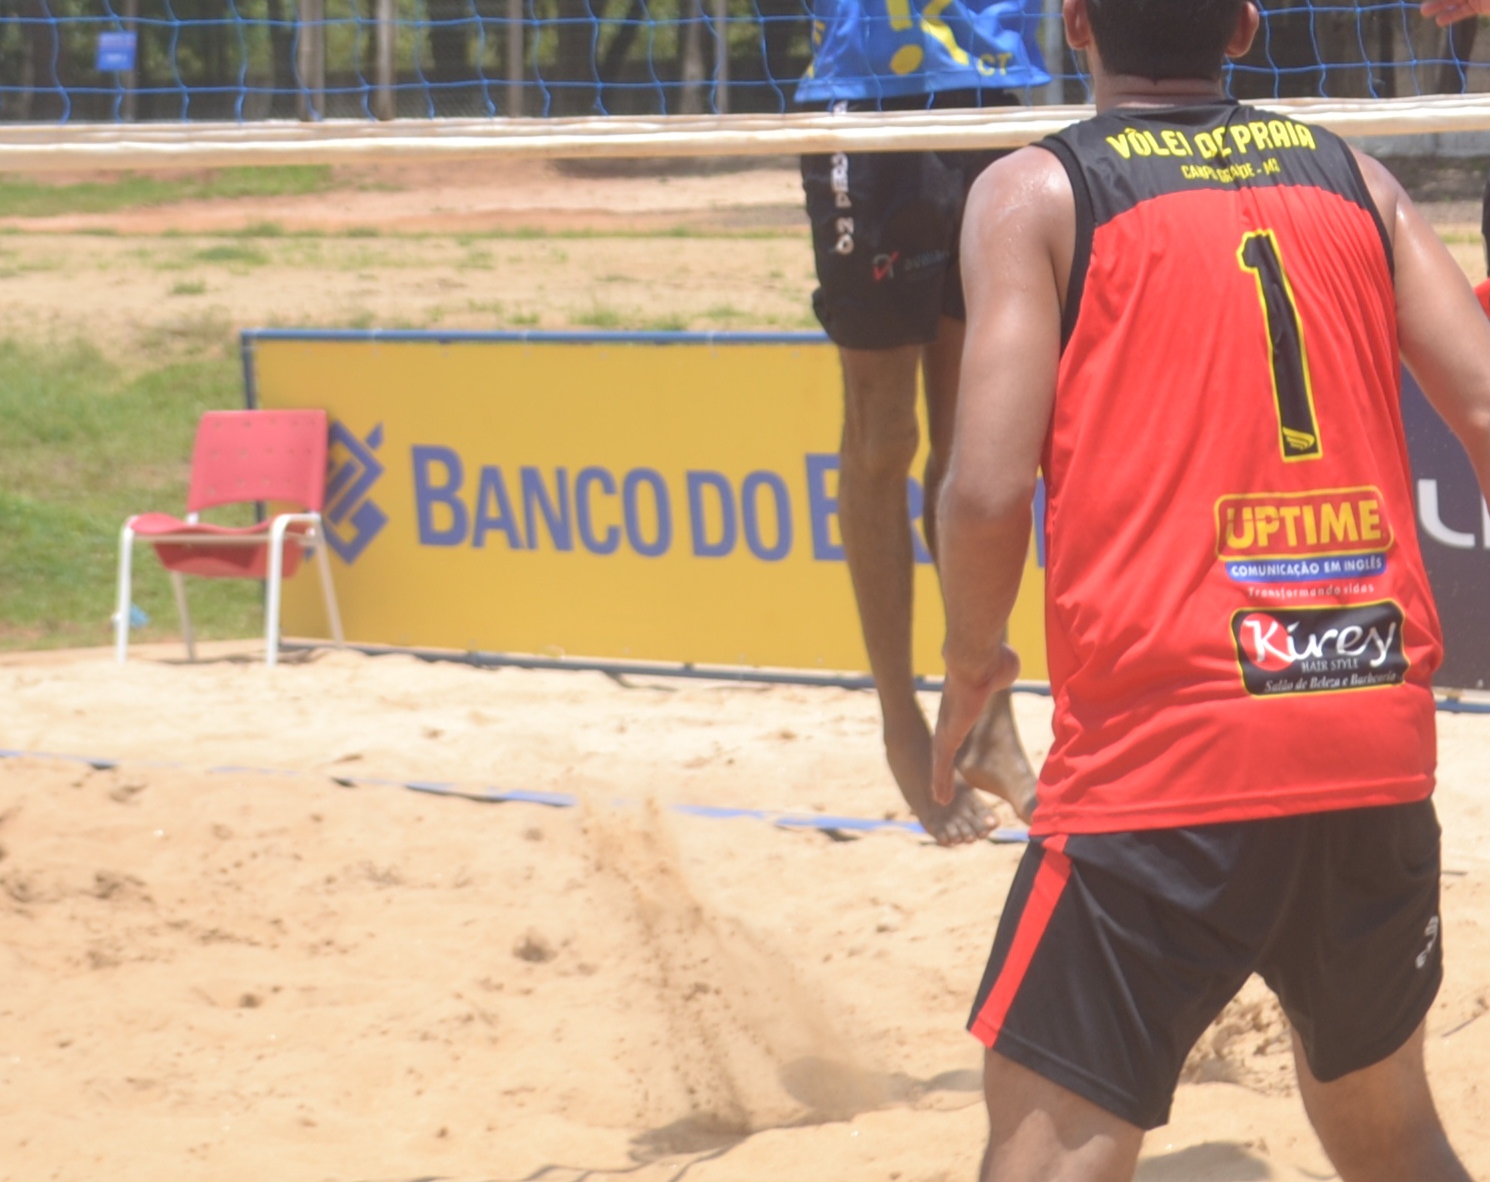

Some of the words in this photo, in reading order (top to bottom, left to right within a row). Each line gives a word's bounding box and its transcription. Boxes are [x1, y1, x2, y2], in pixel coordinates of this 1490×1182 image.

[1105, 127, 1194, 159] VÔLEI
[1230, 120, 1316, 155] PRAIA
[1236, 228, 1323, 462] 1
[411, 444, 673, 559] BANCO
[686, 468, 794, 563] DO
[1225, 499, 1382, 550] UPTIME
[1231, 560, 1320, 580] COMUNICAÇÃO
[1323, 558, 1343, 574] EM
[1344, 555, 1382, 572] INGLÊS
[1247, 584, 1341, 600] Transformando
[1343, 582, 1375, 596] vidas
[1302, 660, 1329, 672] HAIR
[1264, 677, 1294, 693] Salão
[1295, 677, 1307, 691] de
[1309, 674, 1341, 690] Beleza
